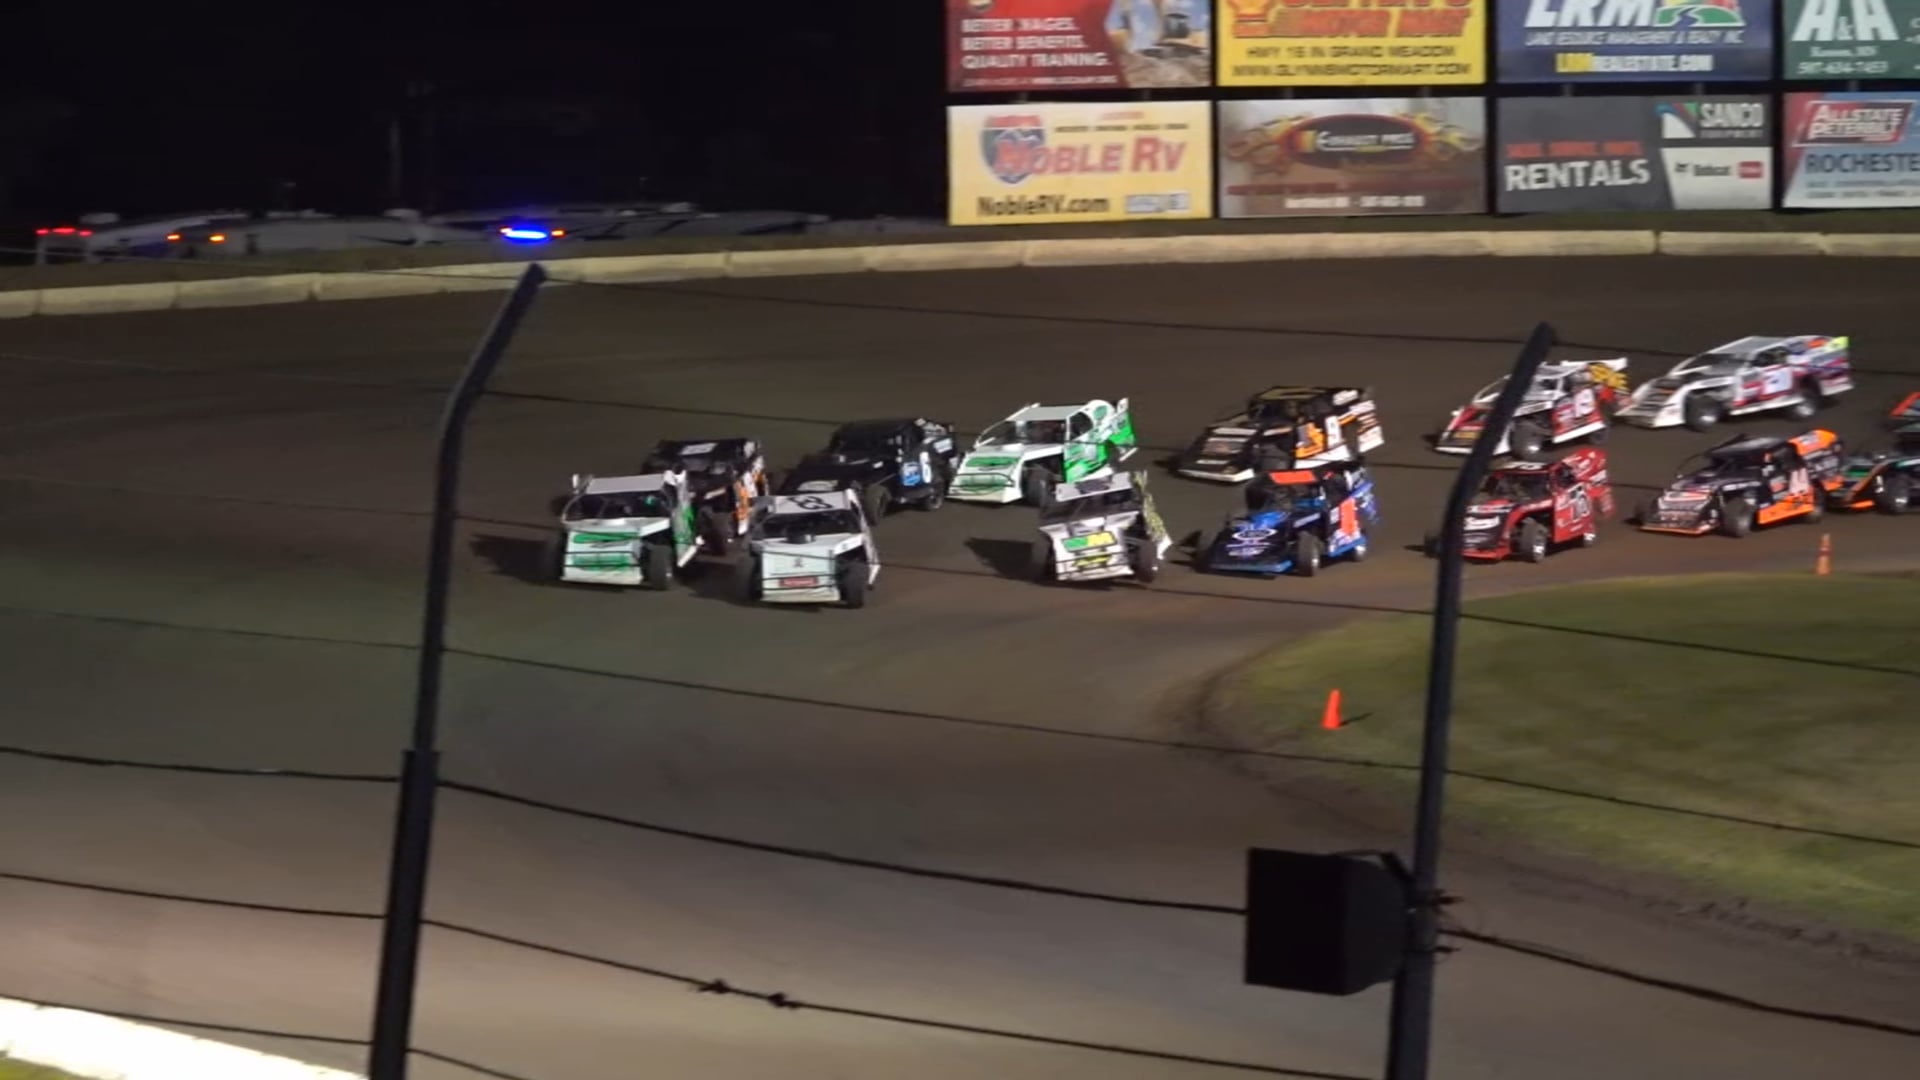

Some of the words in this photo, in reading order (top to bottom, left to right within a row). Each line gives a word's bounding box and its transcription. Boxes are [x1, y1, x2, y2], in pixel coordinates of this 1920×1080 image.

[962, 18, 1013, 33] BETTER
[961, 36, 1013, 51] BETTER
[961, 54, 1028, 70] QUALITY
[1031, 52, 1112, 67] TRAINING.
[1700, 102, 1764, 129] SANCO
[993, 140, 1126, 176] NOBLE
[1504, 159, 1650, 191] RENTALS
[976, 194, 1110, 216] NobleRV.com
